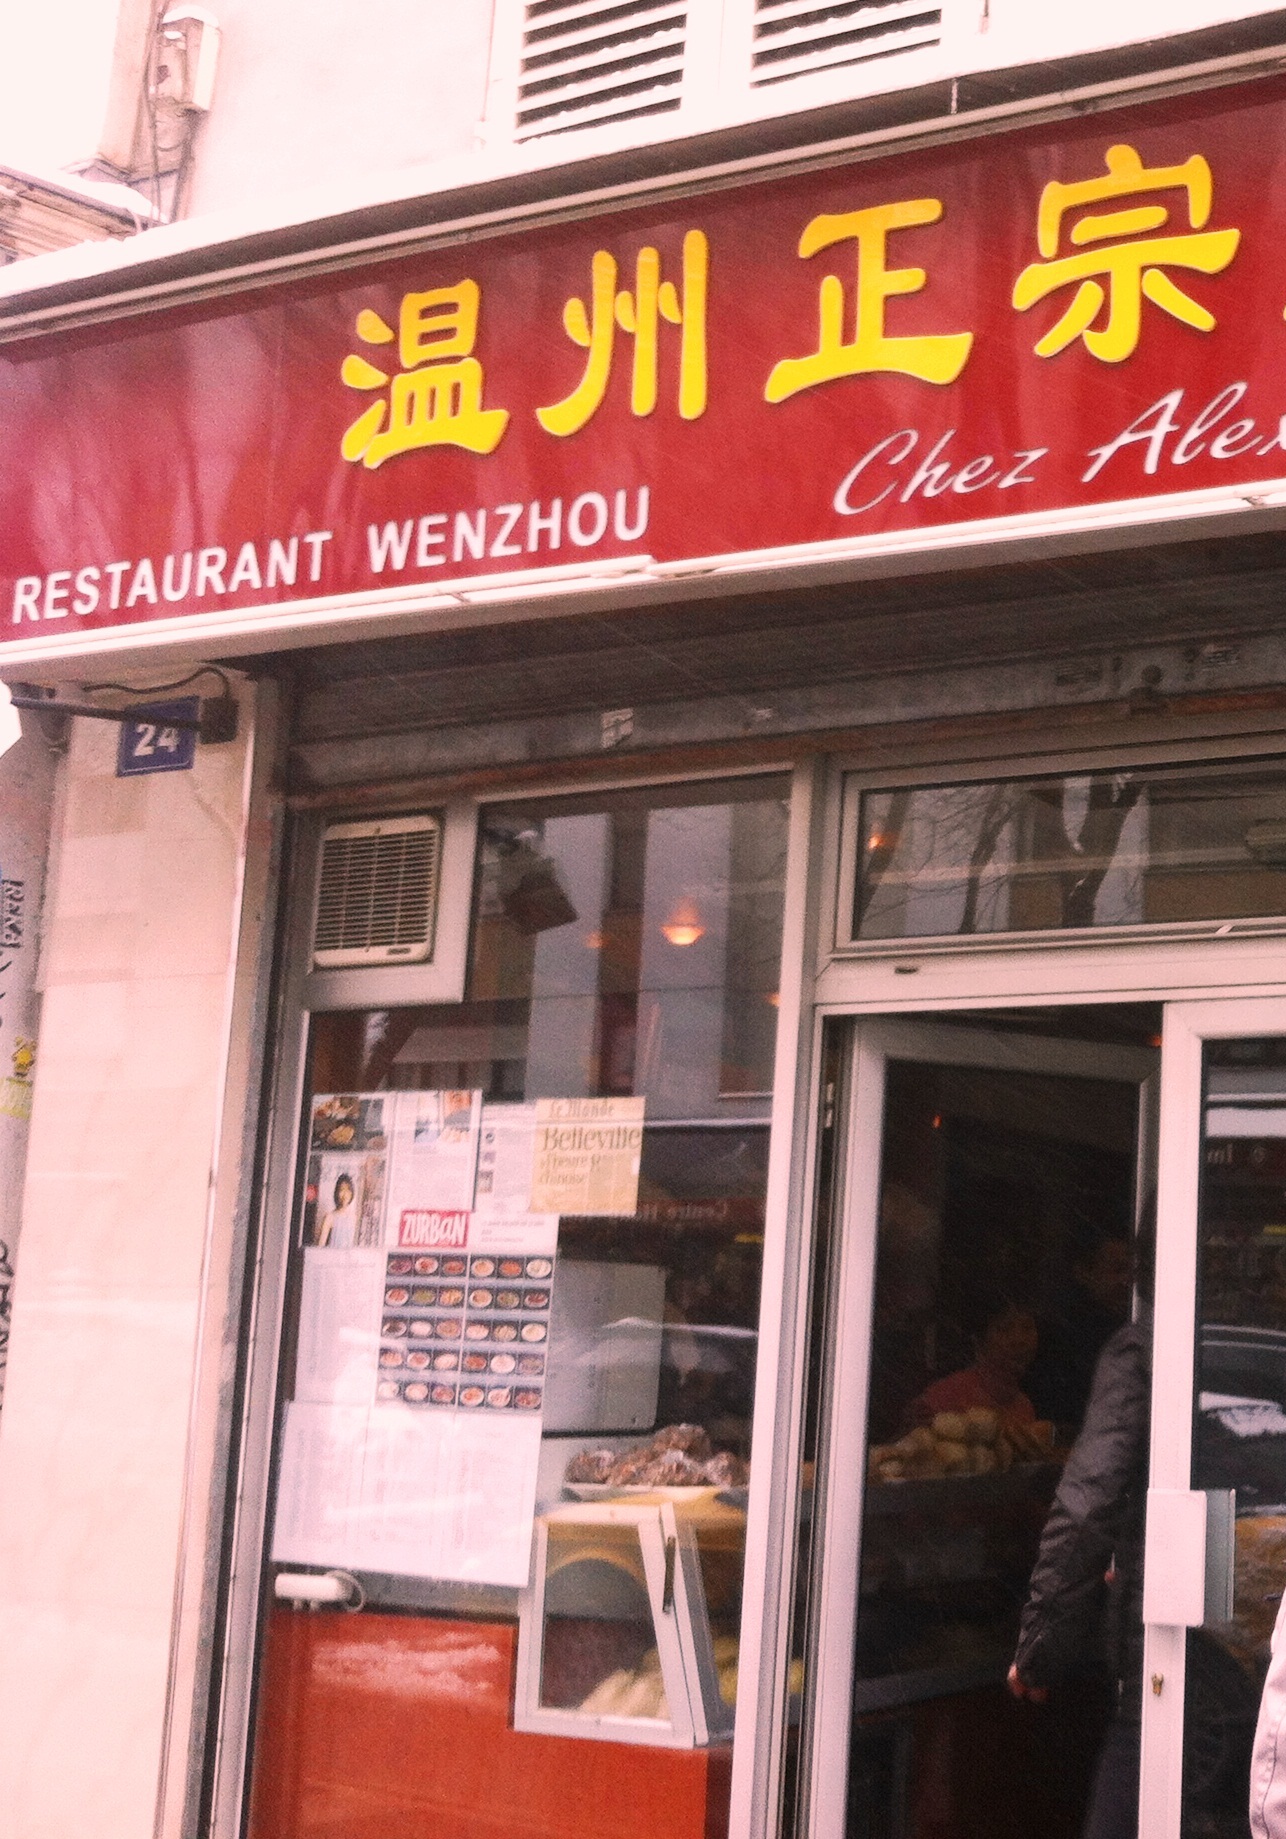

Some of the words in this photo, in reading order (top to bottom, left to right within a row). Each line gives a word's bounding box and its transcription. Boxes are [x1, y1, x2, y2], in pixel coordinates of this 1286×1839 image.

[833, 427, 1050, 517] Chez
[11, 530, 333, 624] RESTAURANT
[367, 485, 651, 574] WENZHOU
[133, 723, 179, 757] 24
[542, 1127, 641, 1151] Belleville
